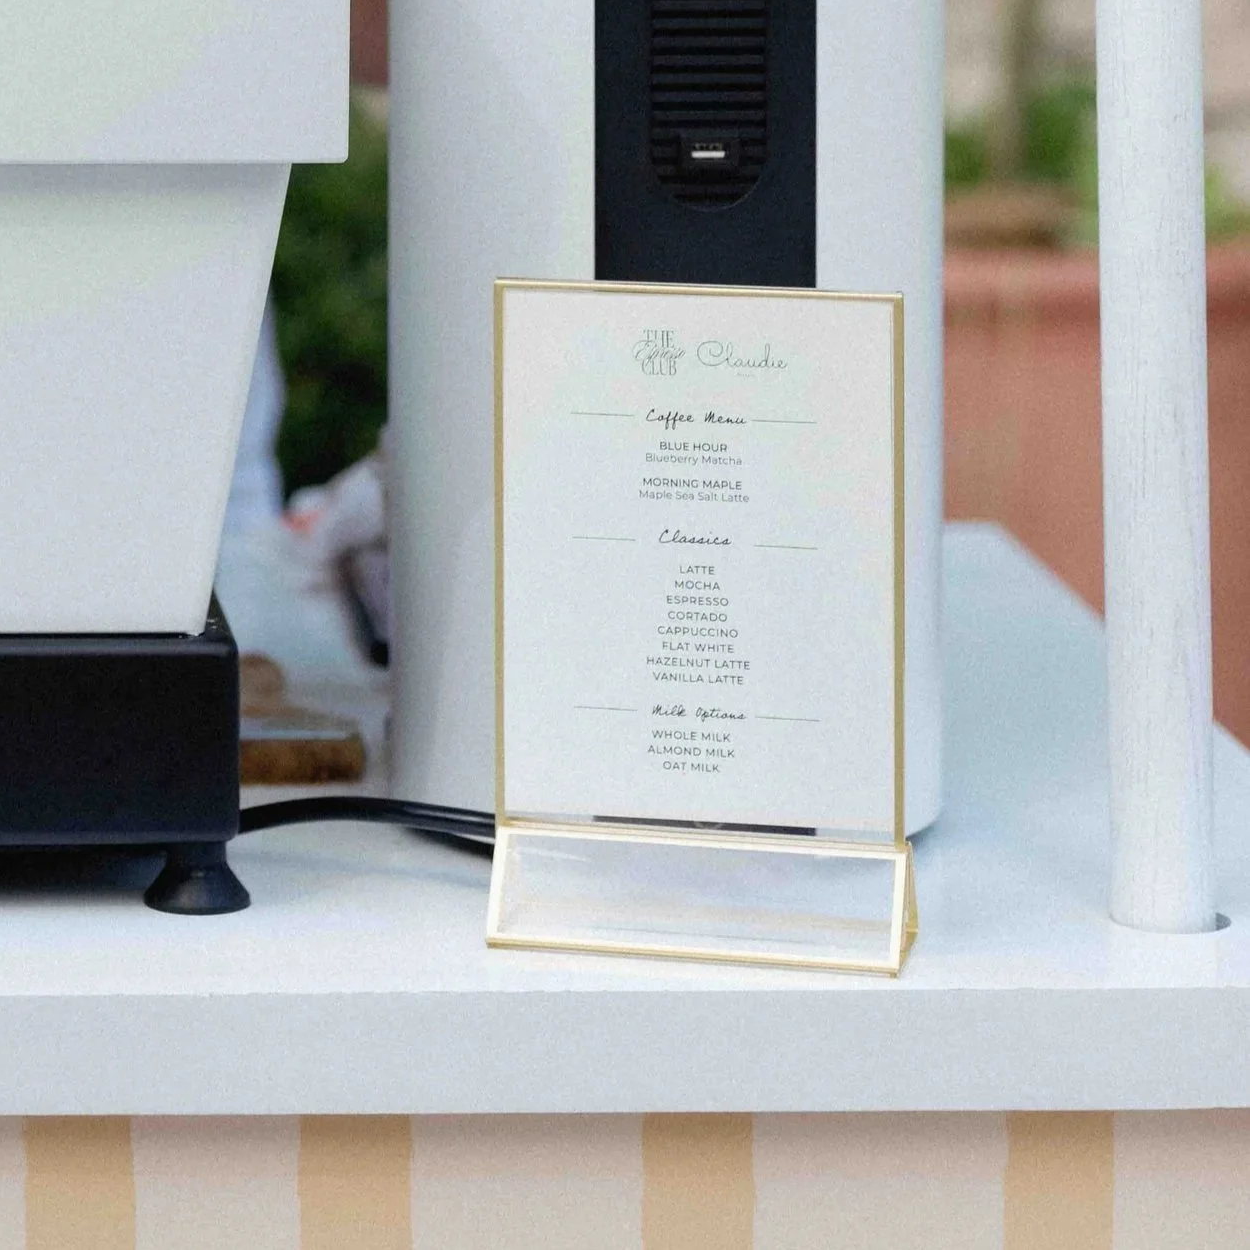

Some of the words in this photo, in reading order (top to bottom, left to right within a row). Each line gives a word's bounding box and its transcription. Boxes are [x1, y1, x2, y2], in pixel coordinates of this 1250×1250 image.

[643, 329, 675, 349] THE
[696, 340, 788, 370] Claudie
[641, 356, 677, 376] CLUB
[646, 408, 694, 430] Coffee
[704, 411, 748, 425] Menu
[659, 441, 689, 452] BLUE
[693, 442, 728, 453] HOUR
[645, 453, 699, 467] Blueberry
[702, 455, 743, 466] Matcha
[642, 477, 699, 489] MORNING
[702, 479, 743, 491] MAPLE
[638, 489, 673, 502] Maple
[675, 490, 695, 501] Sea
[698, 490, 718, 502] Salt
[721, 492, 750, 504] Latte
[658, 528, 732, 546] Classics
[679, 565, 715, 575] LATTE
[674, 580, 721, 591] MOCHA
[666, 595, 729, 607] ESPRESSO
[667, 611, 728, 622] CORTADO
[657, 625, 739, 638] CAPPUCCINO
[662, 641, 690, 651] FLAT
[694, 643, 735, 653] WHITE
[646, 656, 710, 668] HAZELNUT
[714, 658, 751, 670] LATTE
[652, 671, 704, 683] VANILLA
[708, 674, 744, 685] LATTE
[652, 704, 687, 717] Milk
[695, 706, 747, 722] Options
[651, 730, 697, 741] WHOLE
[701, 731, 731, 743] MILK
[647, 744, 701, 757] ALMOND
[705, 748, 735, 758] MILK
[662, 761, 686, 771] OAT
[690, 762, 720, 773] MILK
